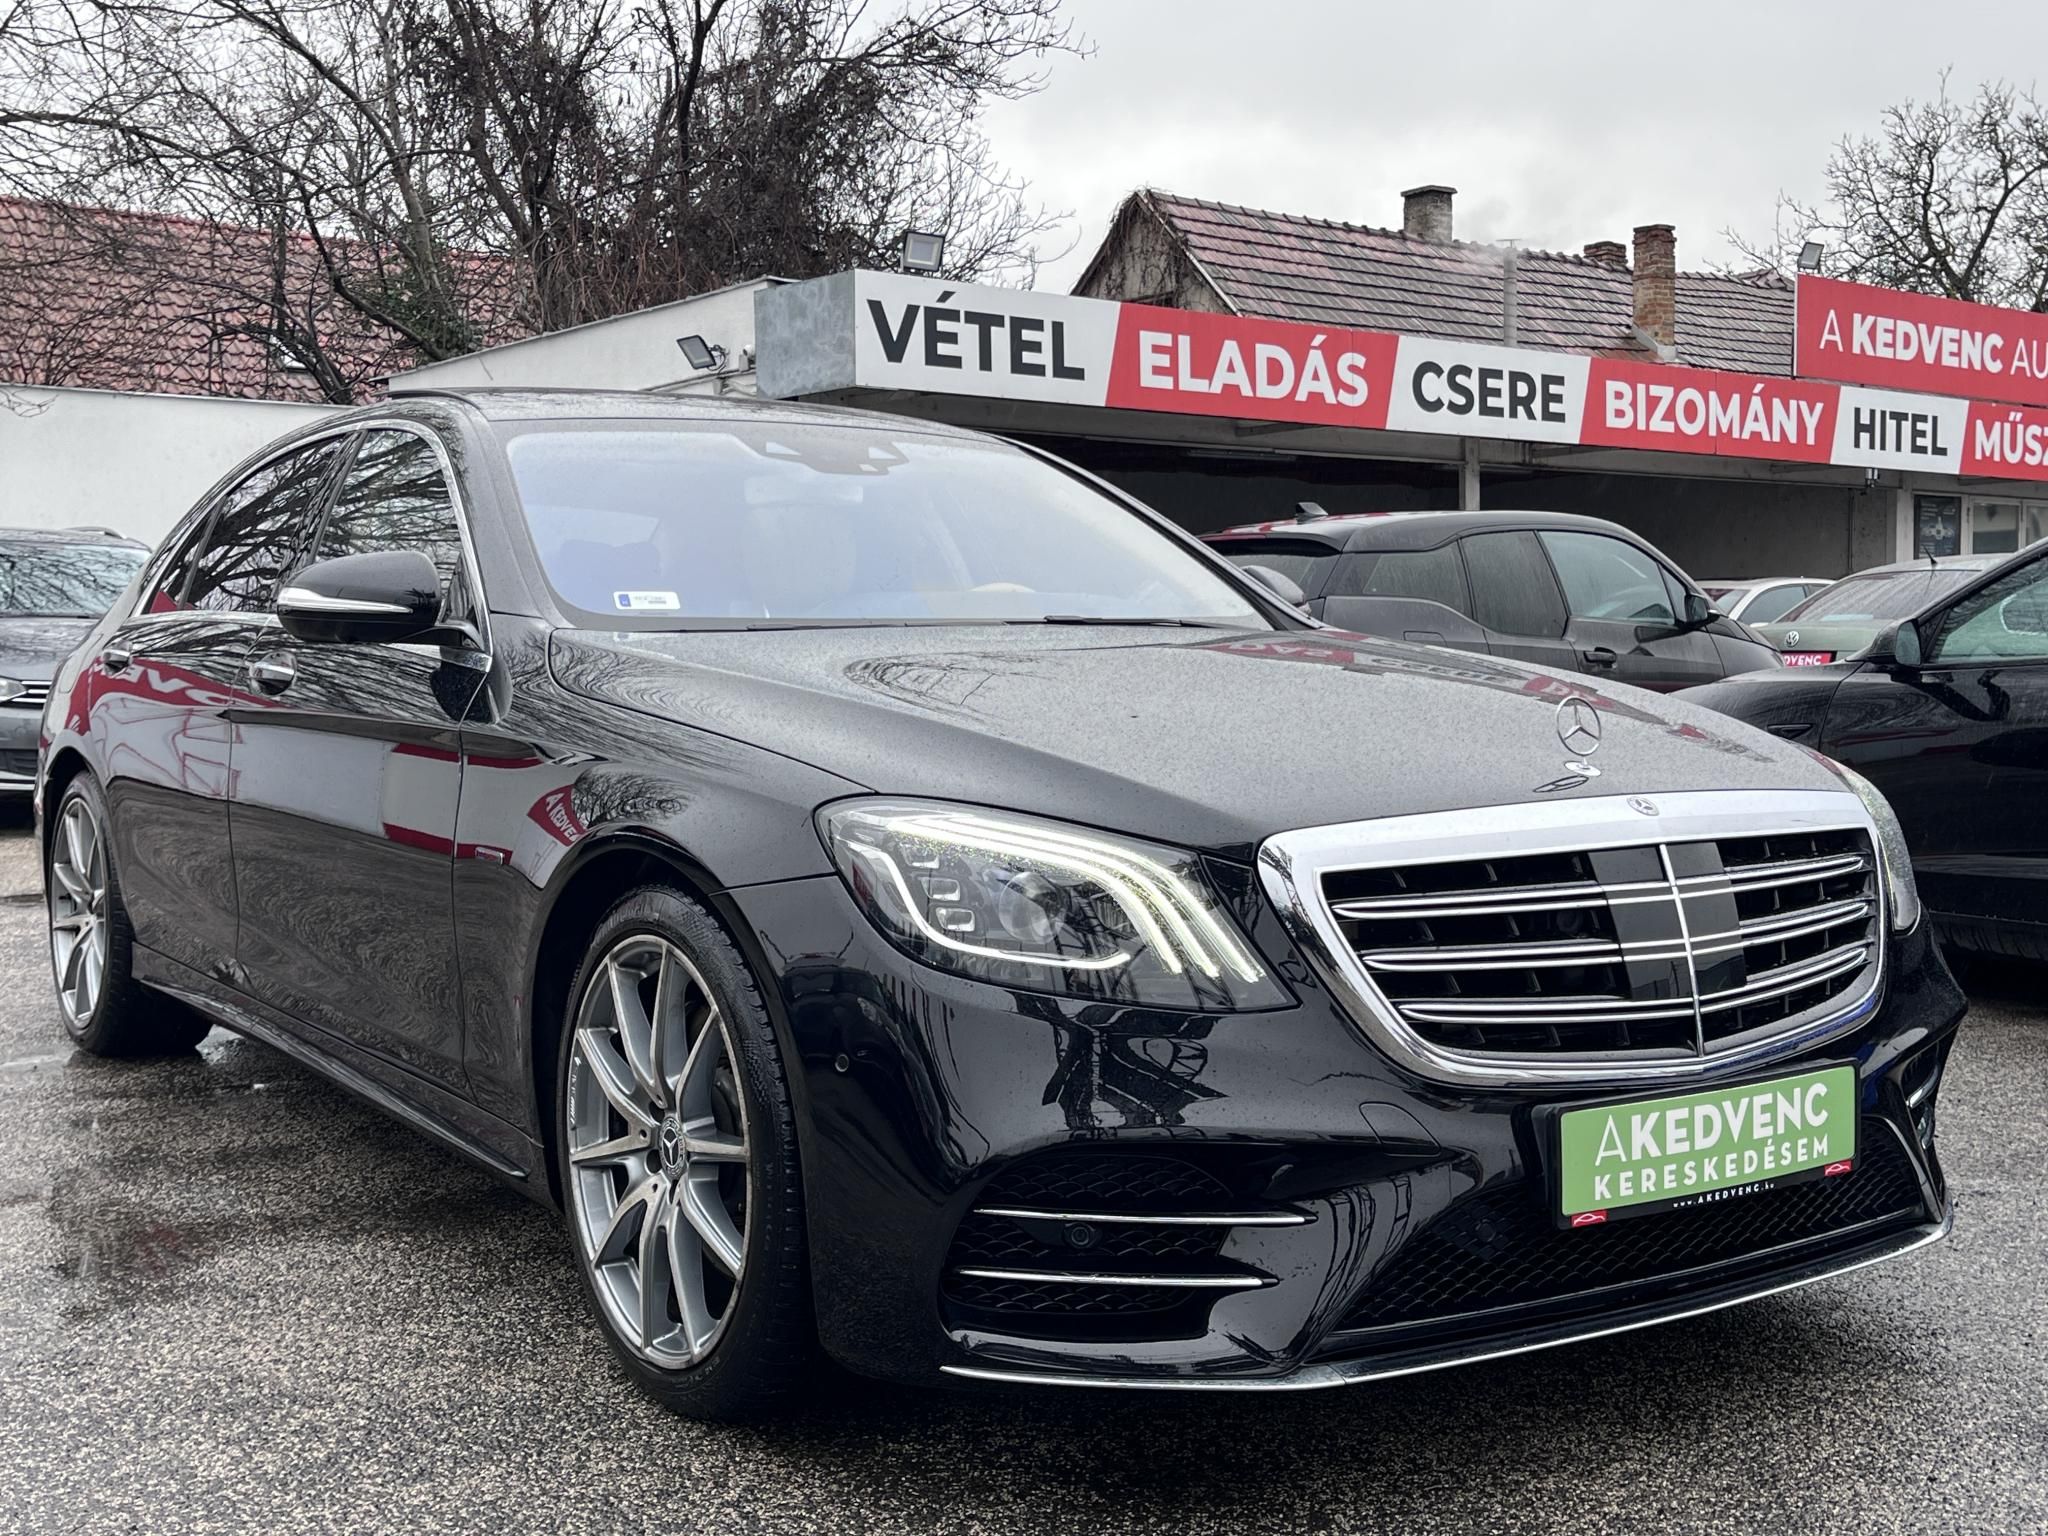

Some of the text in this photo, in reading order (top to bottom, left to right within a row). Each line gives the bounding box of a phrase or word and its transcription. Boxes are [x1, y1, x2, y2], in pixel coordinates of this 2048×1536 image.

[866, 291, 1085, 380] VÉTEL
[1138, 330, 1369, 407] ELADÁS
[1411, 361, 1566, 423] CSERE
[1604, 380, 1824, 445] BIZOMÁNY
[1853, 406, 1948, 456] HITEL
[1819, 309, 1844, 352] A
[1852, 312, 2004, 374] KEDVENC
[1594, 1134, 1829, 1200] KERESKEDÉSEM
